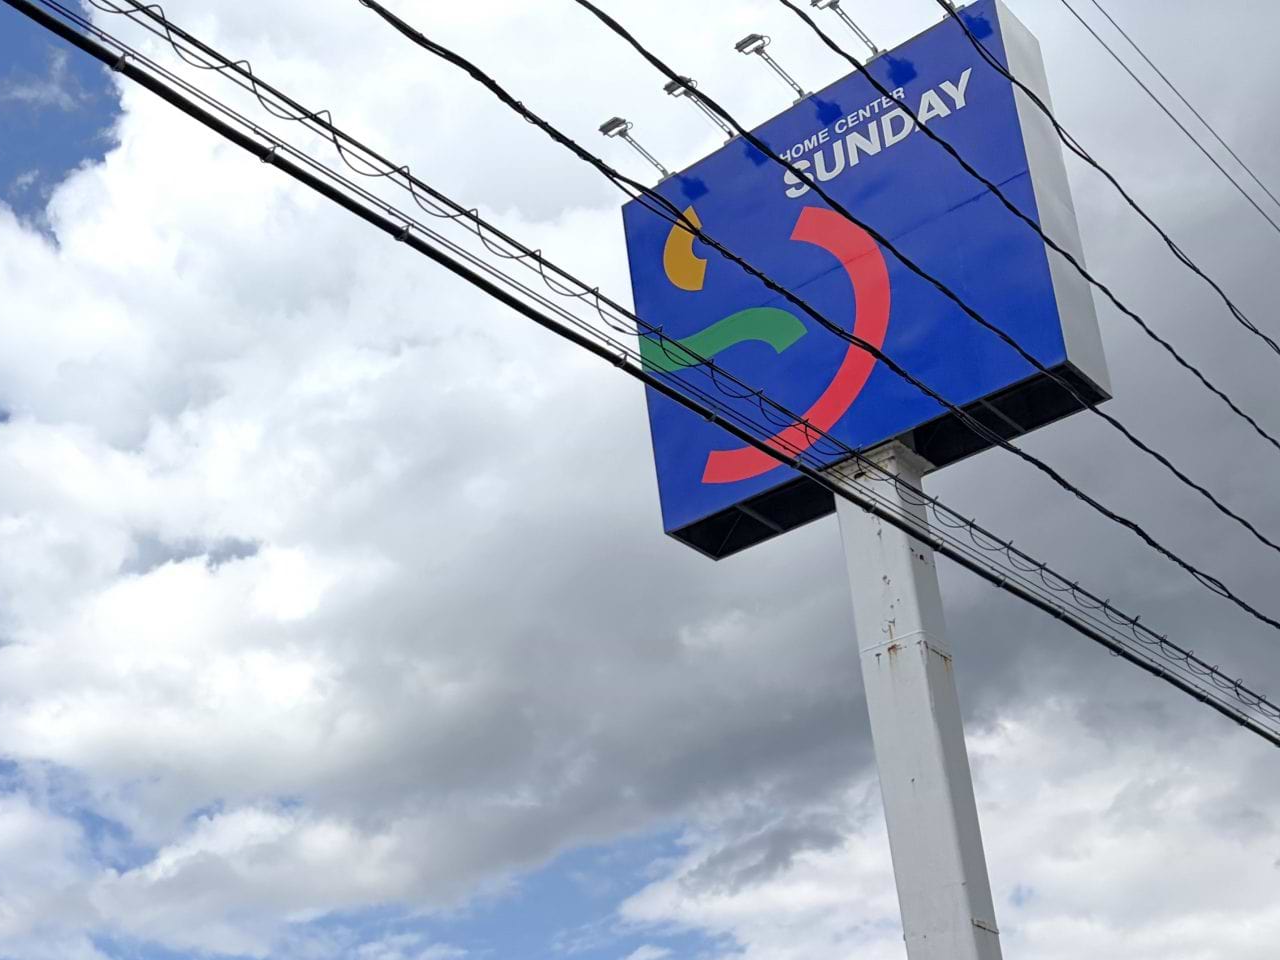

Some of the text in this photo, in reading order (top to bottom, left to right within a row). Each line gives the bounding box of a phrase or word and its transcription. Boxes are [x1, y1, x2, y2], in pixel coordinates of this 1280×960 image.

[779, 86, 905, 162] HOME CENTER
[783, 67, 972, 199] SUNDAY
